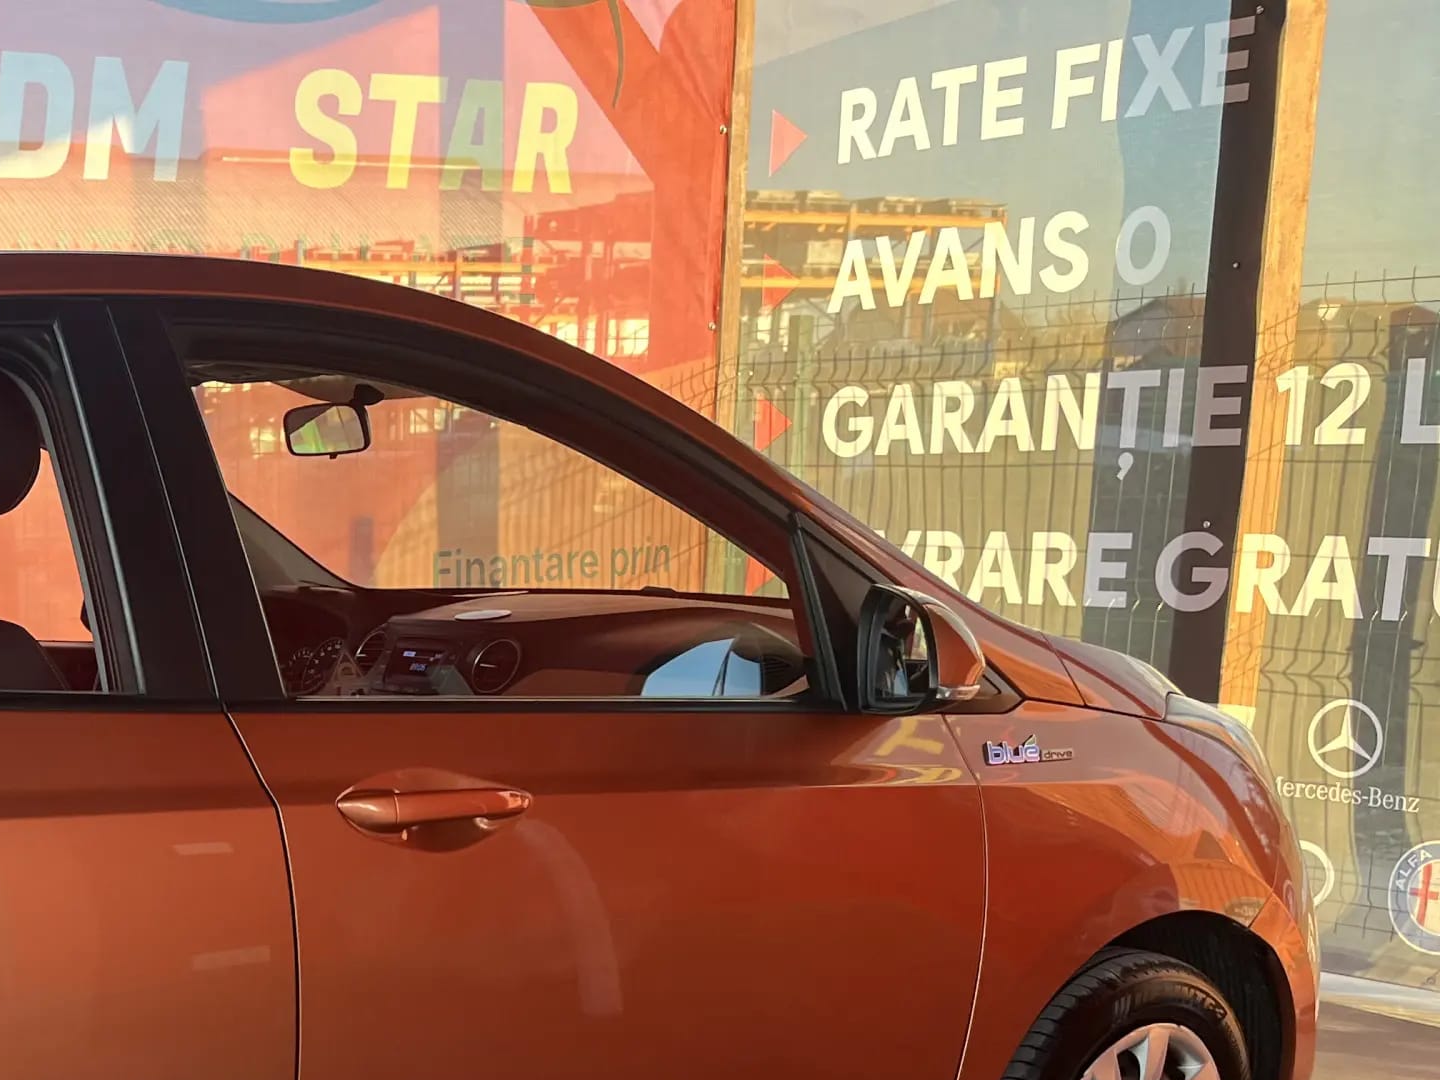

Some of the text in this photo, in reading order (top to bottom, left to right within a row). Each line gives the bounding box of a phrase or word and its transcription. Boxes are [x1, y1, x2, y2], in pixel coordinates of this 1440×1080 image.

[289, 68, 579, 194] STAR
[837, 16, 1256, 164] RATE FIXE
[826, 210, 1090, 314] AVANS
[821, 364, 1250, 481] GARANȚIE
[1275, 362, 1372, 446] 12
[611, 535, 671, 587] prin
[1155, 530, 1440, 622] GRAT
[985, 734, 1040, 765] blue
[1395, 848, 1433, 891] ALFA
